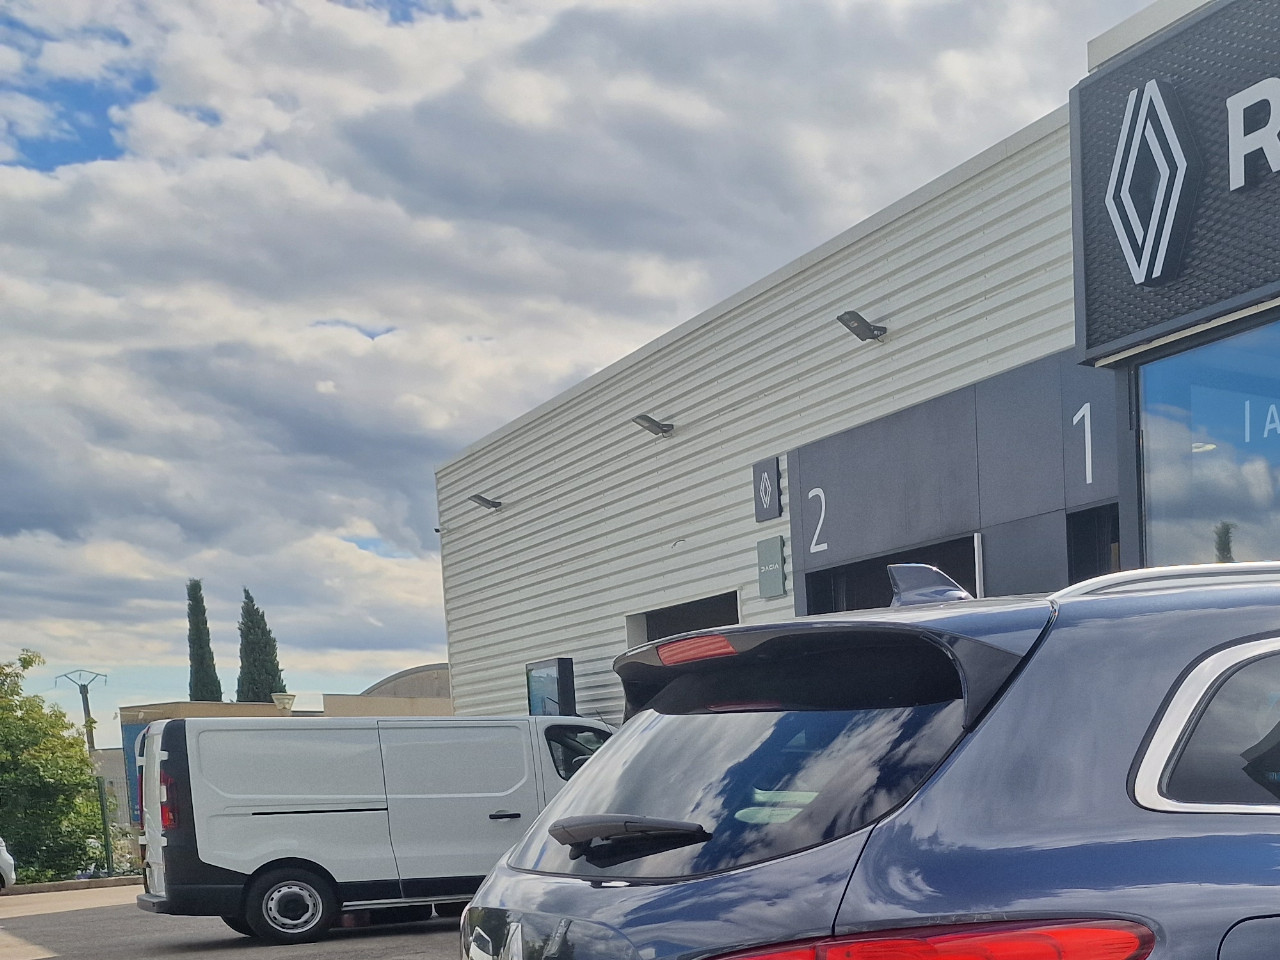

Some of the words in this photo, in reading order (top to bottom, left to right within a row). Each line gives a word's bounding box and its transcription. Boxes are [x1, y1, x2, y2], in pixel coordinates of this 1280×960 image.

[1072, 402, 1092, 485] 1
[808, 487, 828, 554] 2
[760, 563, 779, 573] DACIA
